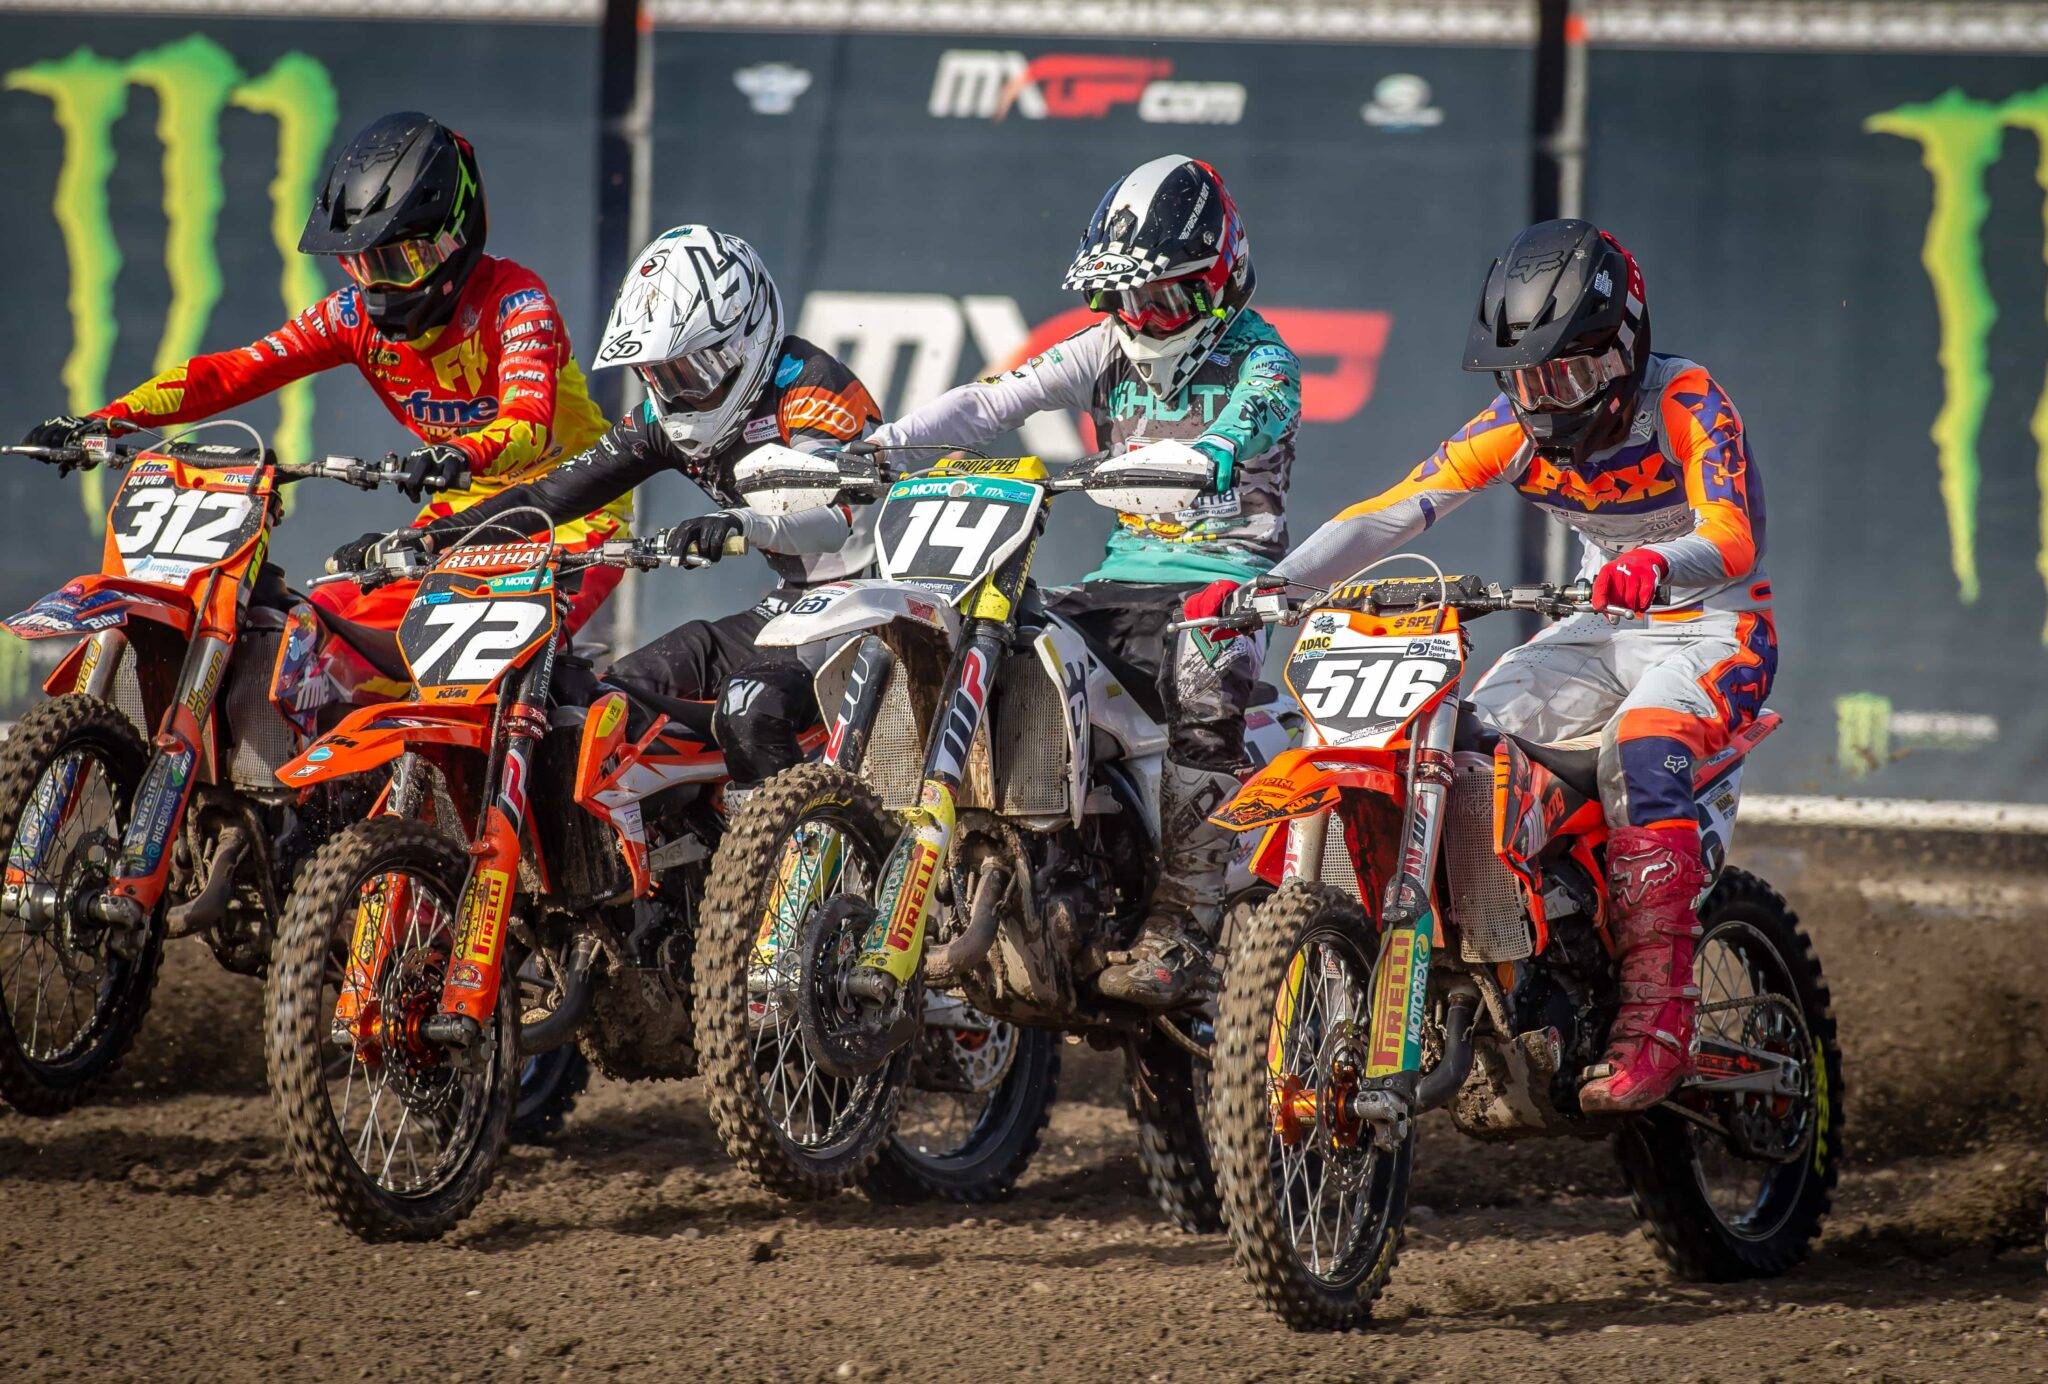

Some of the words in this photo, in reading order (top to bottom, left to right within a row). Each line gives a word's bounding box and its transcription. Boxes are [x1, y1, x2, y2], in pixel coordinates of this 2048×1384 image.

[128, 475, 165, 486] OLIVER
[115, 487, 253, 560] 312
[889, 501, 1010, 576] 14
[82, 613, 120, 630] Bihr
[411, 602, 547, 681] 72
[1300, 637, 1331, 650] ADAC
[1432, 638, 1450, 646] ADAC
[1302, 659, 1448, 719] 516
[473, 877, 502, 958] PIRELLI
[885, 843, 938, 951] PIRELLI
[1372, 935, 1410, 1069] PIRELLI
[1408, 959, 1430, 1046] MOTOREX
